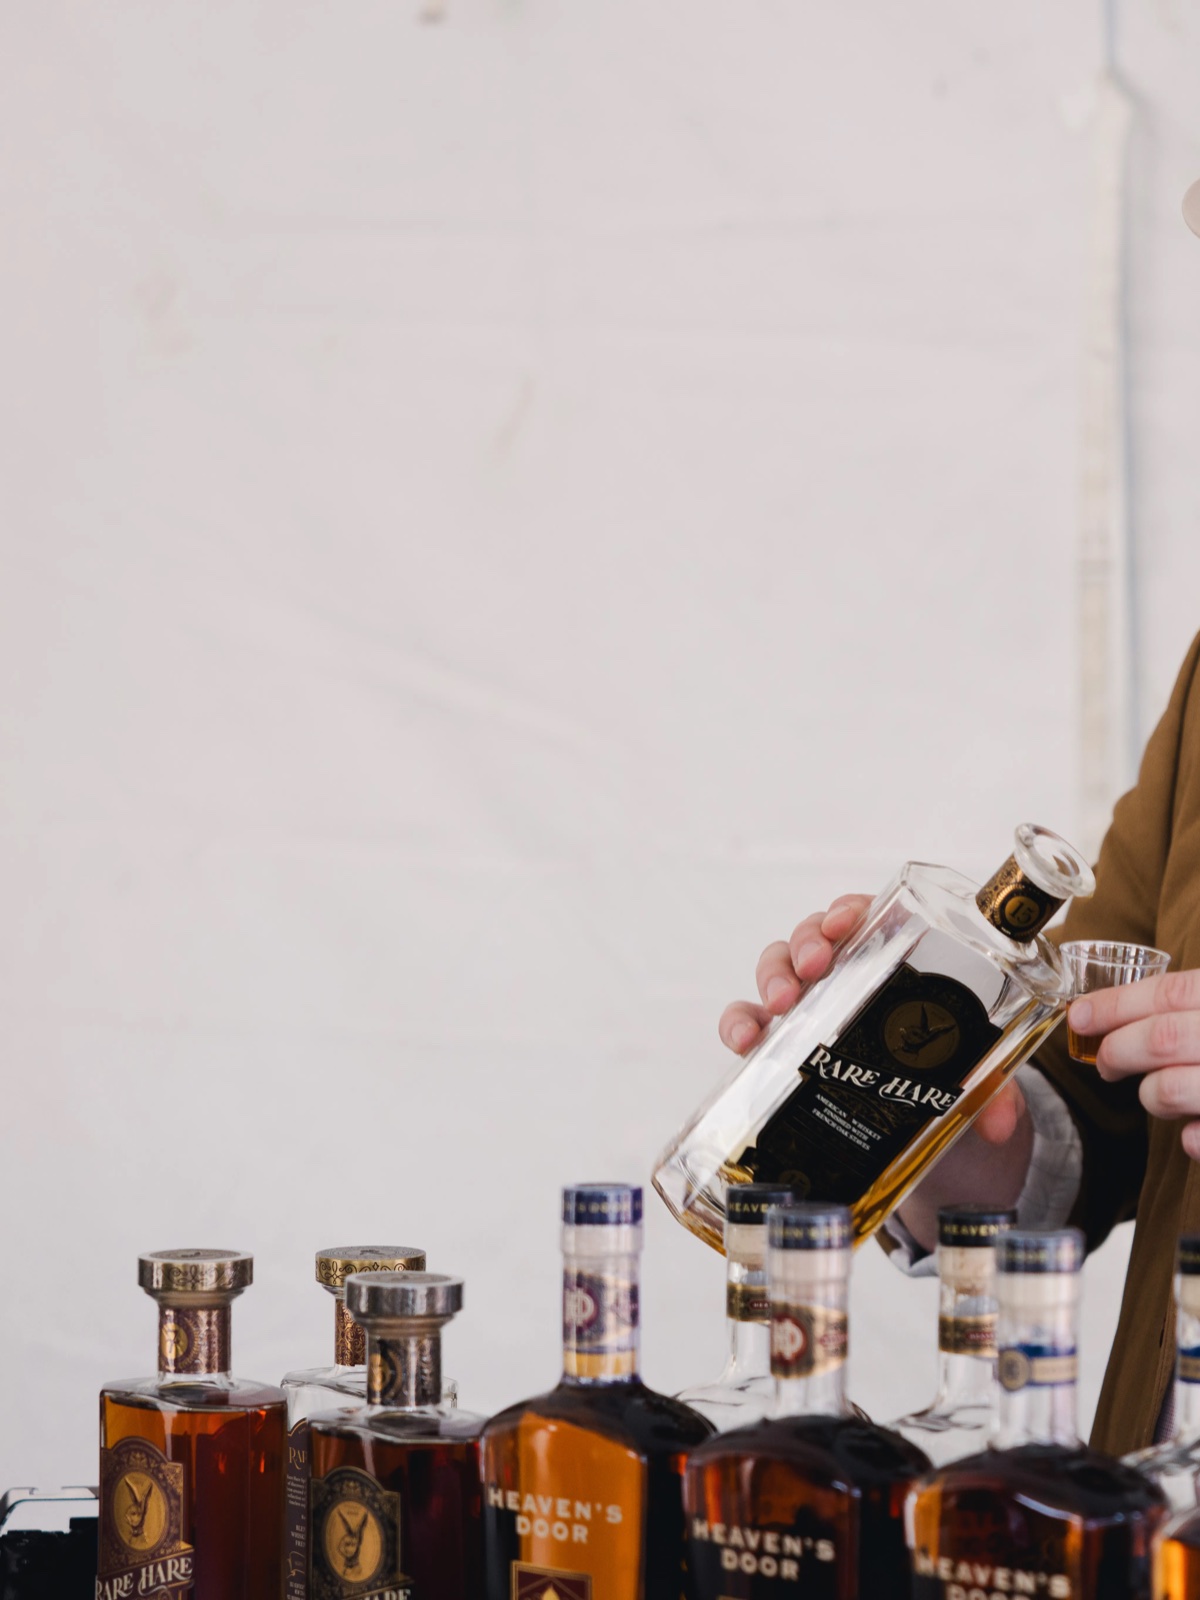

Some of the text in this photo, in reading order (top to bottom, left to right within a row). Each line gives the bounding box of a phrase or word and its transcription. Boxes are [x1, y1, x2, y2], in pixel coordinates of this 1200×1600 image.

[809, 1048, 957, 1111] RARE HARE
[811, 1108, 837, 1128] FRENCH
[815, 1093, 882, 1142] AMERICAN WHISKEY
[822, 1107, 869, 1142] FINISHED WITH
[488, 1487, 623, 1524] HEAVEN'S
[515, 1515, 589, 1544] DOOR
[691, 1517, 836, 1562] HEAVEN'S
[138, 1557, 194, 1597] HARE
[720, 1548, 800, 1580] DOOR
[915, 1552, 1072, 1600] HEAVEN'S
[946, 1582, 1033, 1600] DO
